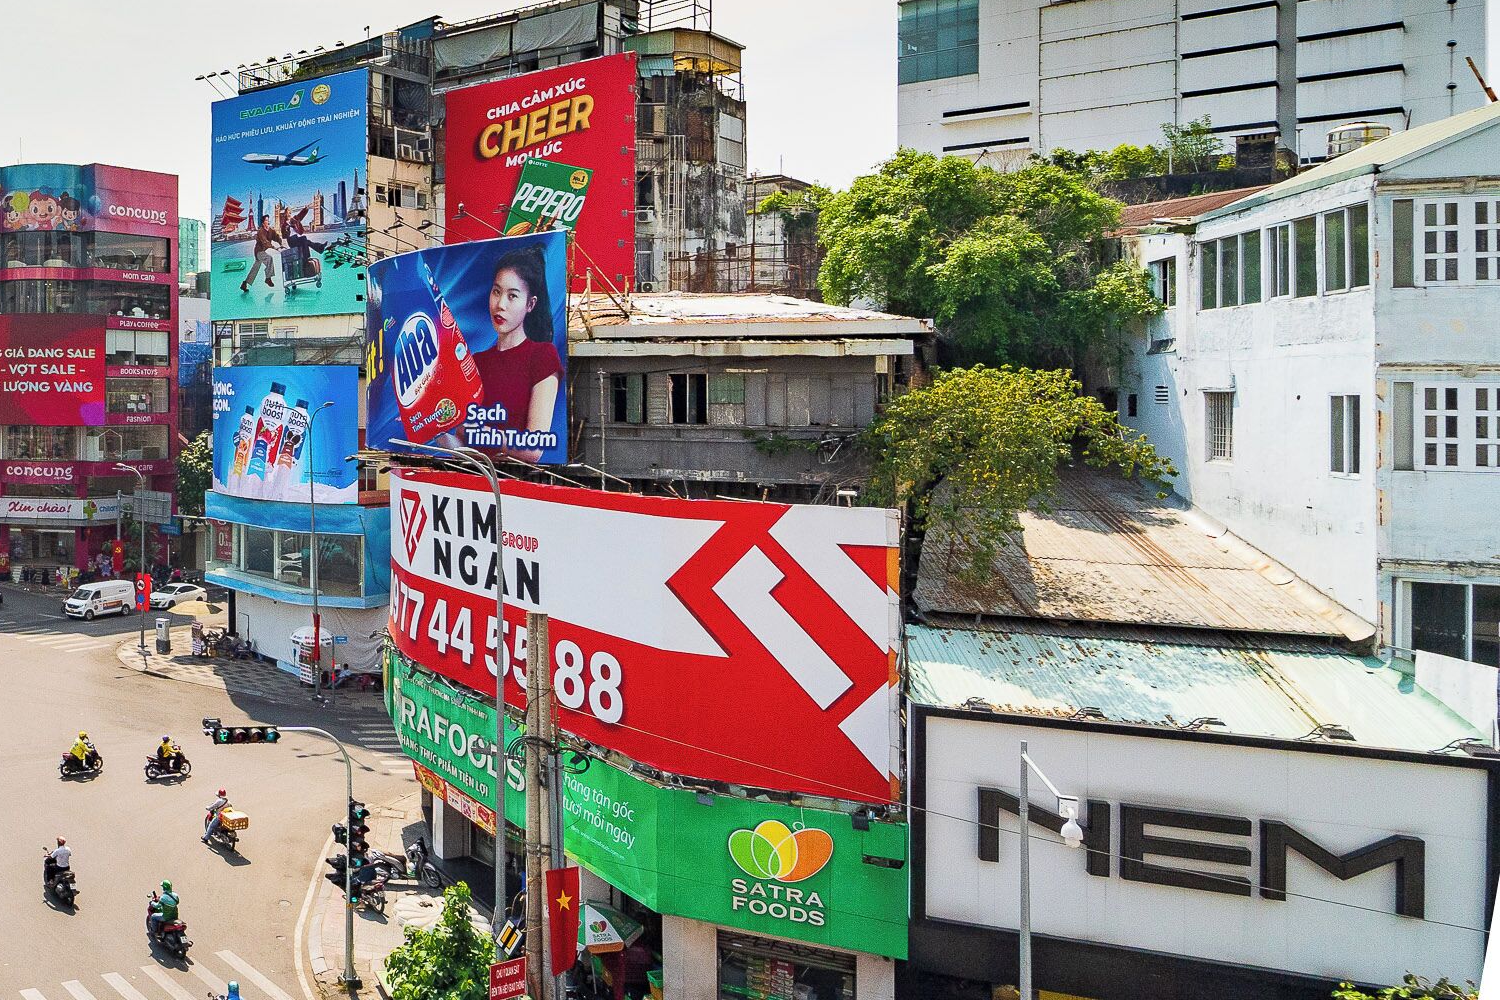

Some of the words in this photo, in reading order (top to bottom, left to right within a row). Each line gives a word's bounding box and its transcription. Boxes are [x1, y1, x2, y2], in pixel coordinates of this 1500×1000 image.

[486, 103, 521, 120] CHIA
[521, 88, 554, 109] CẢM
[554, 77, 586, 97] XÚC
[241, 128, 259, 138] PHIÊU
[298, 117, 316, 129] ĐỘNG
[333, 108, 360, 121] NGHIỆM
[479, 94, 594, 159] CHEER
[535, 140, 563, 160] LÚC
[511, 182, 586, 222] PEPERO
[4, 346, 25, 358] GIÁ
[66, 348, 96, 358] SALE
[395, 320, 438, 397] Aba
[3, 380, 51, 394] LƯỢNG
[53, 379, 94, 393] VÀNG
[8, 363, 38, 377] VỢT
[40, 364, 76, 375] SALE
[466, 403, 506, 425] Sạch
[466, 429, 502, 446] Tinh
[504, 430, 557, 447] Tươm
[7, 500, 33, 513] Xin
[35, 500, 72, 514] chào!
[431, 494, 498, 545] KIM
[501, 530, 539, 553] GROUP
[434, 537, 540, 606] NGAN
[428, 599, 475, 666] 44
[554, 639, 624, 724] 88
[419, 746, 437, 765] THỰC
[437, 755, 458, 778] PHẨM
[458, 768, 475, 788] TIỆN
[475, 780, 489, 797] LỢI
[592, 789, 611, 810] tận
[612, 801, 635, 822] gốc
[583, 809, 605, 831] mỗi
[605, 820, 636, 850] ngày
[976, 785, 1426, 920] NEM
[731, 878, 825, 908] SATRA
[732, 895, 825, 927] FOODS
